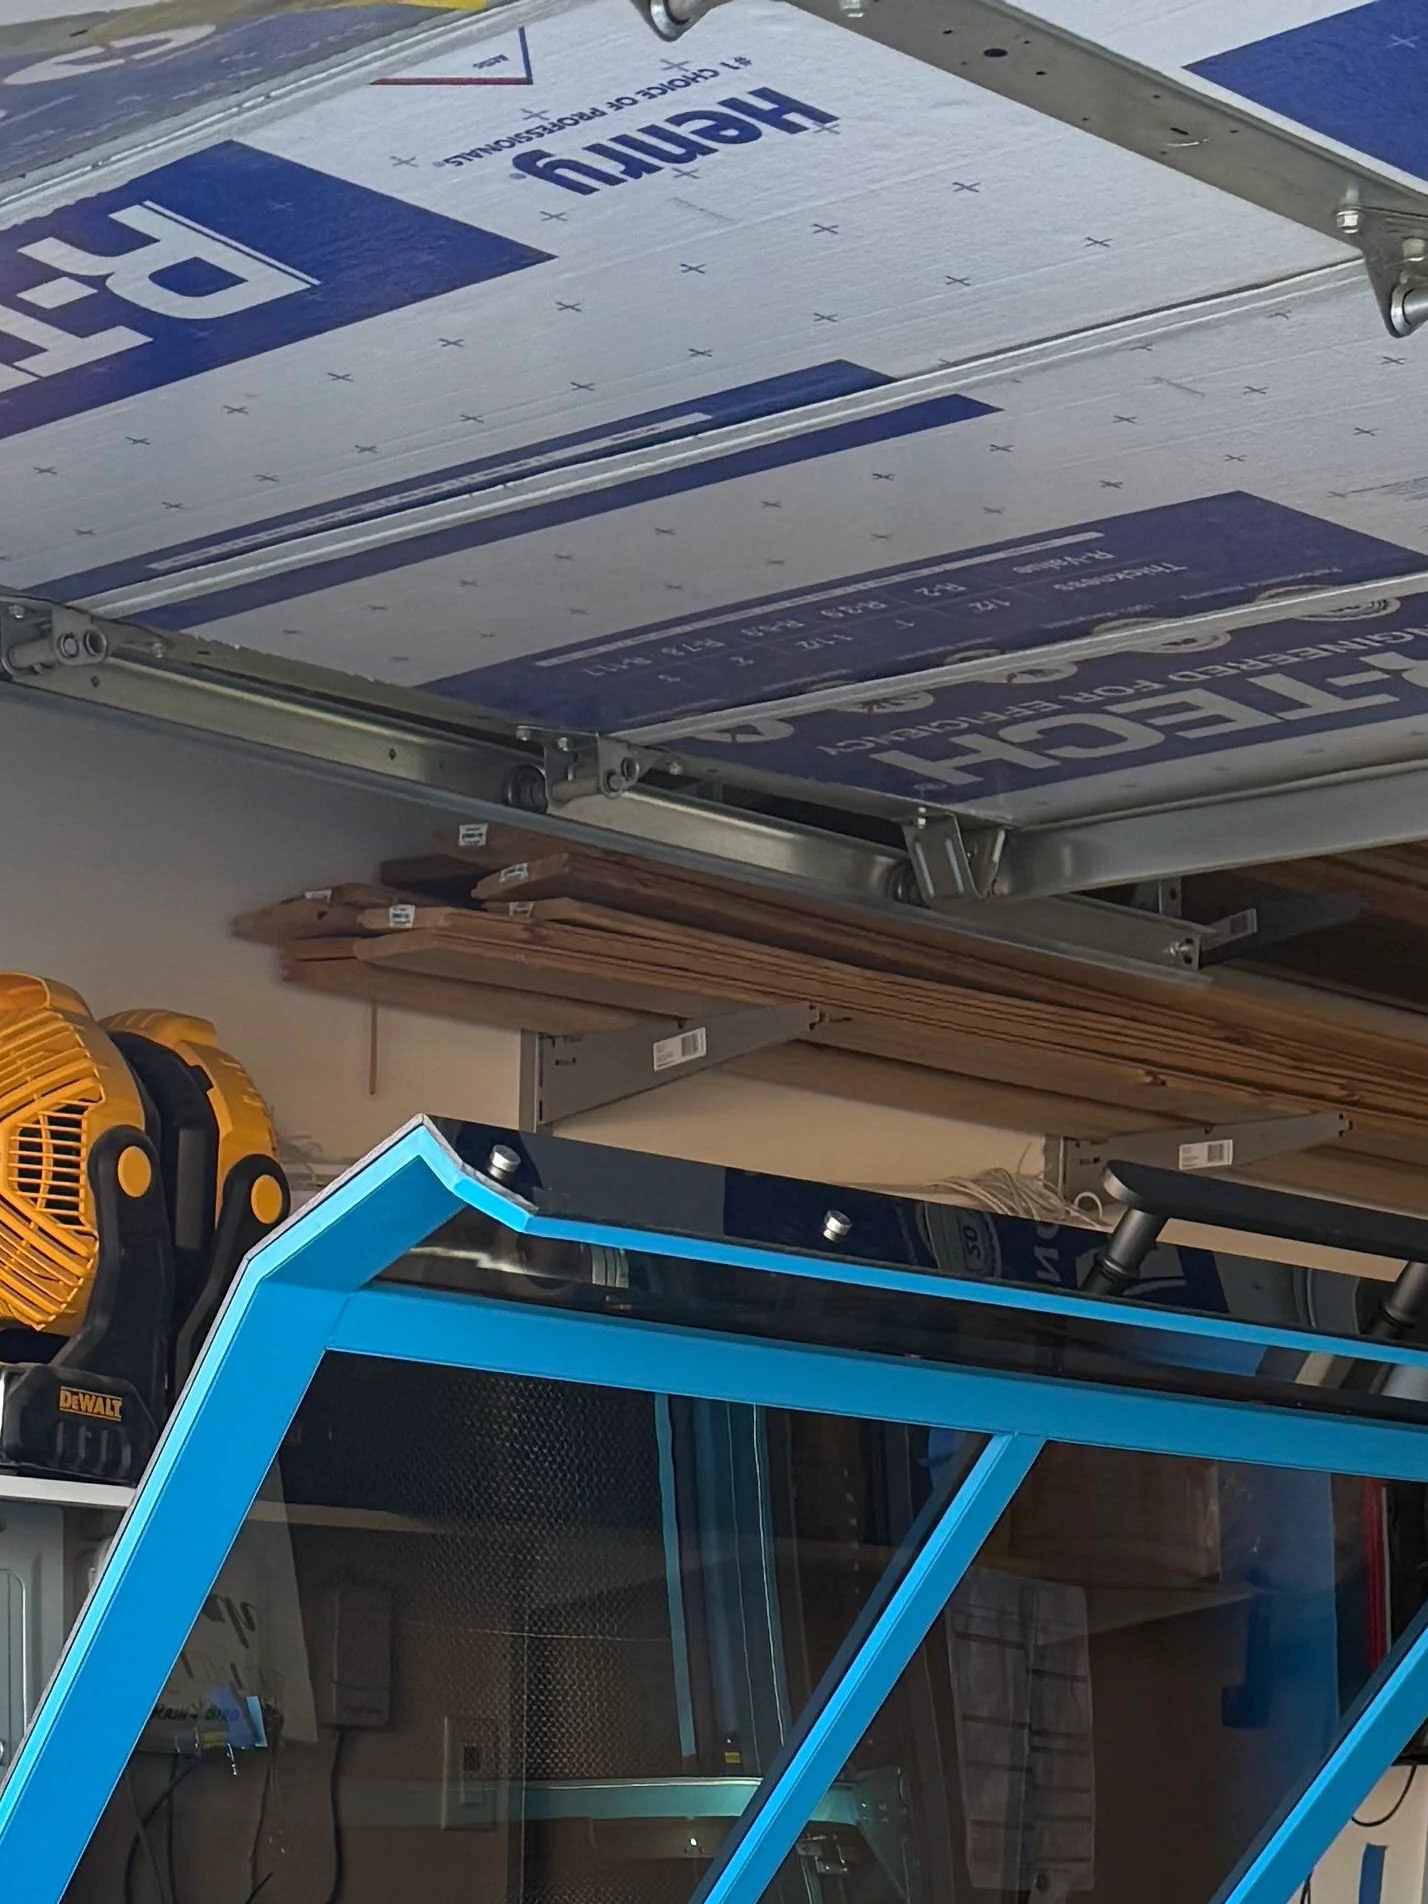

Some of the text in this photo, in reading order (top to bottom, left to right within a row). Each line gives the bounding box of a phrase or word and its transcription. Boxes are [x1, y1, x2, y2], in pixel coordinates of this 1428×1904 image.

[444, 55, 753, 167] #1 CHOICE OF PROFESSIONALS
[513, 86, 840, 196] Henry
[1012, 549, 1115, 574] R-Value
[1054, 562, 1187, 592] Thickness
[1074, 678, 1167, 703] FOR
[817, 700, 1064, 757] EFFICIENCY
